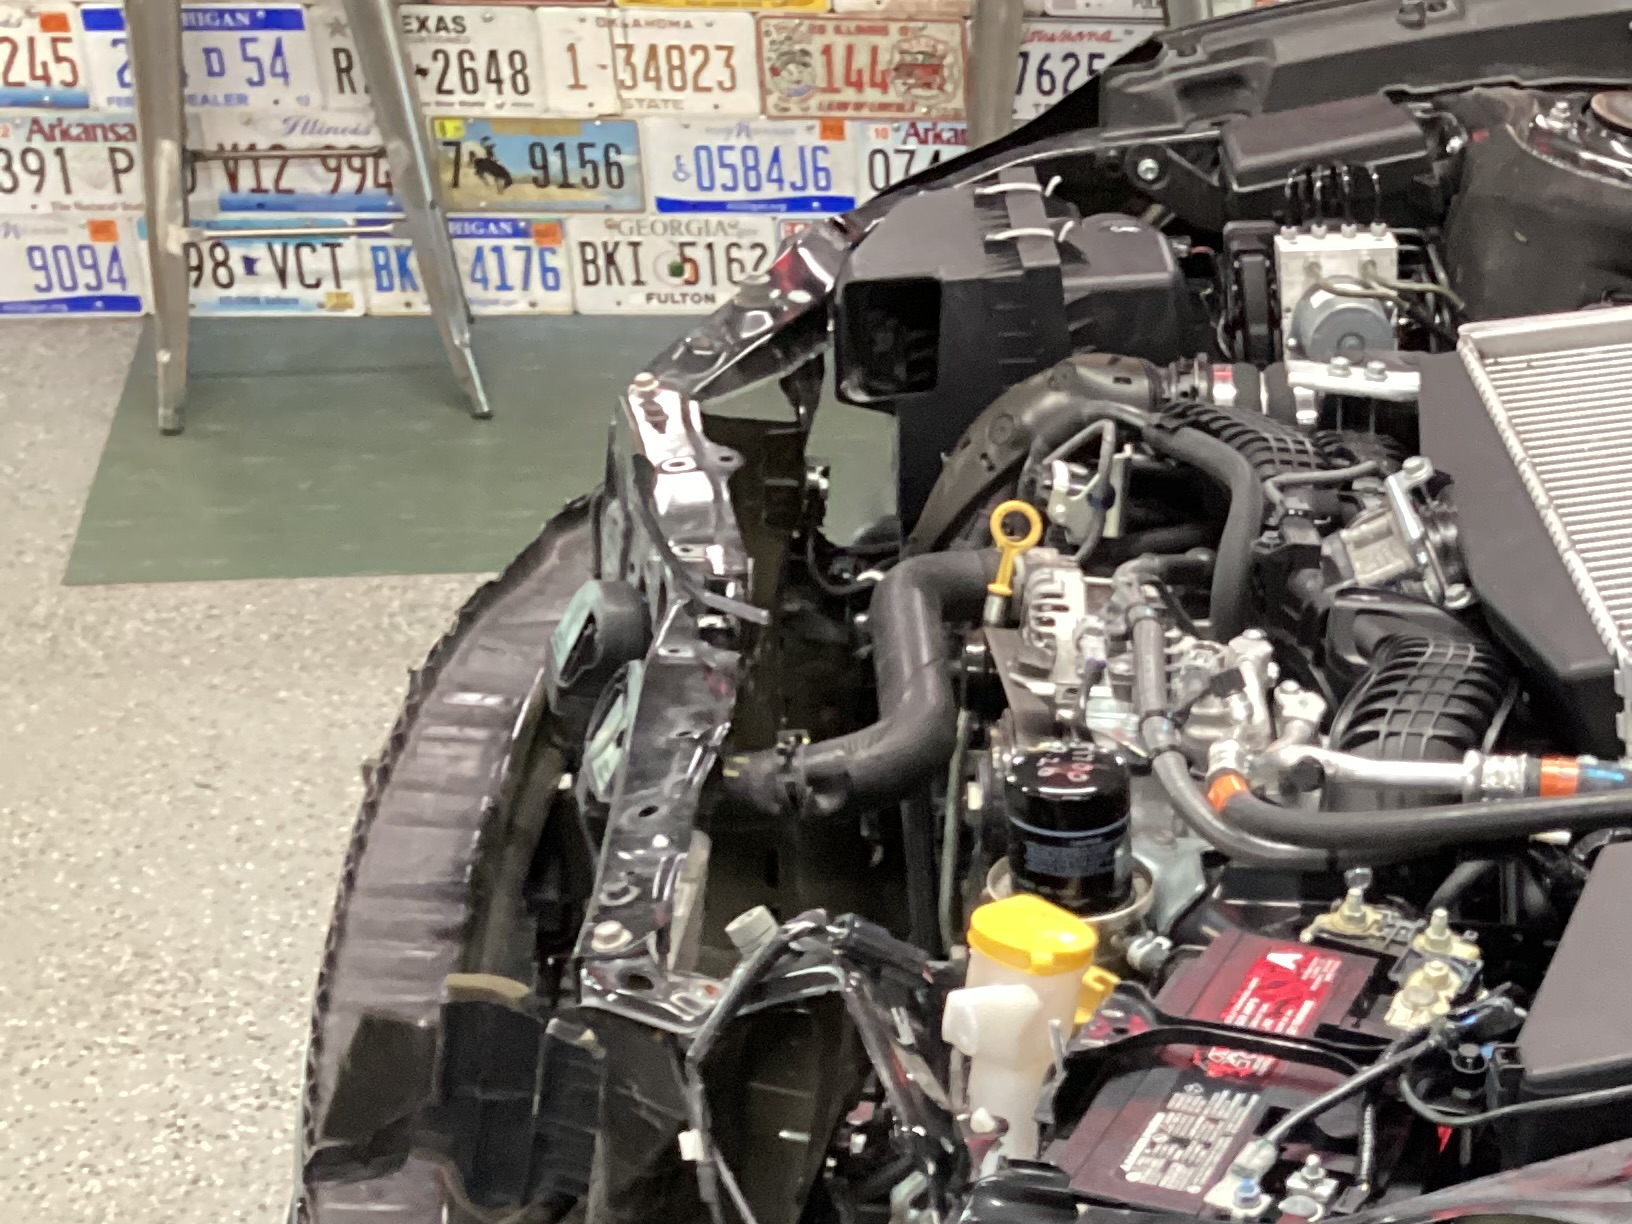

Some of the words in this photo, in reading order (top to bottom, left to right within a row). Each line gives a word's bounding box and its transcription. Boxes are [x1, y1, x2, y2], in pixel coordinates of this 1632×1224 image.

[182, 11, 250, 26] HIGAN
[402, 15, 467, 34] EXAS
[0, 36, 78, 87] 245
[239, 37, 289, 87] 54
[821, 44, 889, 94] 144
[26, 117, 137, 142] Arkansa
[528, 141, 625, 189] 9156
[449, 221, 512, 235] HIGAN
[618, 219, 728, 237] GEORGIA
[26, 245, 127, 292] 9094
[266, 242, 344, 289] VCT
[470, 245, 561, 291] 4176
[578, 241, 646, 286] BKI
[645, 293, 716, 304] FULTON
